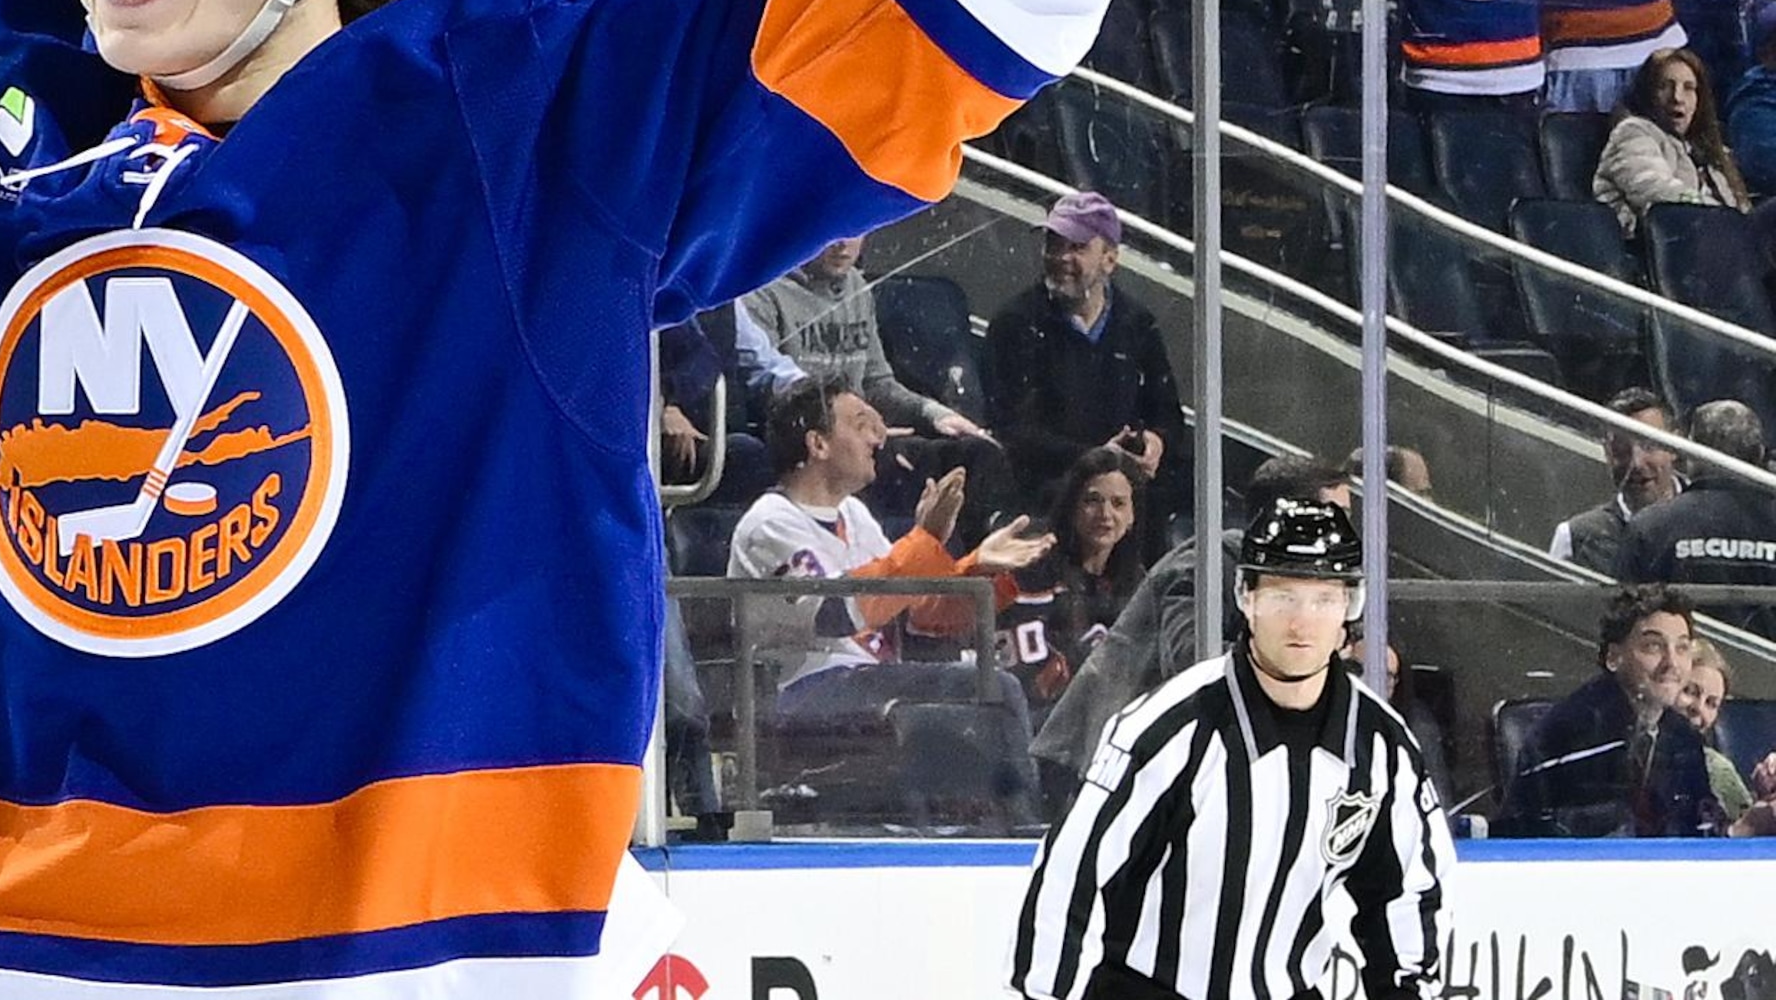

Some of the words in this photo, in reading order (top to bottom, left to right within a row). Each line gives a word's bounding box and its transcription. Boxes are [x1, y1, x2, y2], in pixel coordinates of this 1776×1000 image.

[37, 276, 252, 424] NY
[6, 481, 284, 608] ISLANDERS
[1675, 537, 1776, 561] SECURIT
